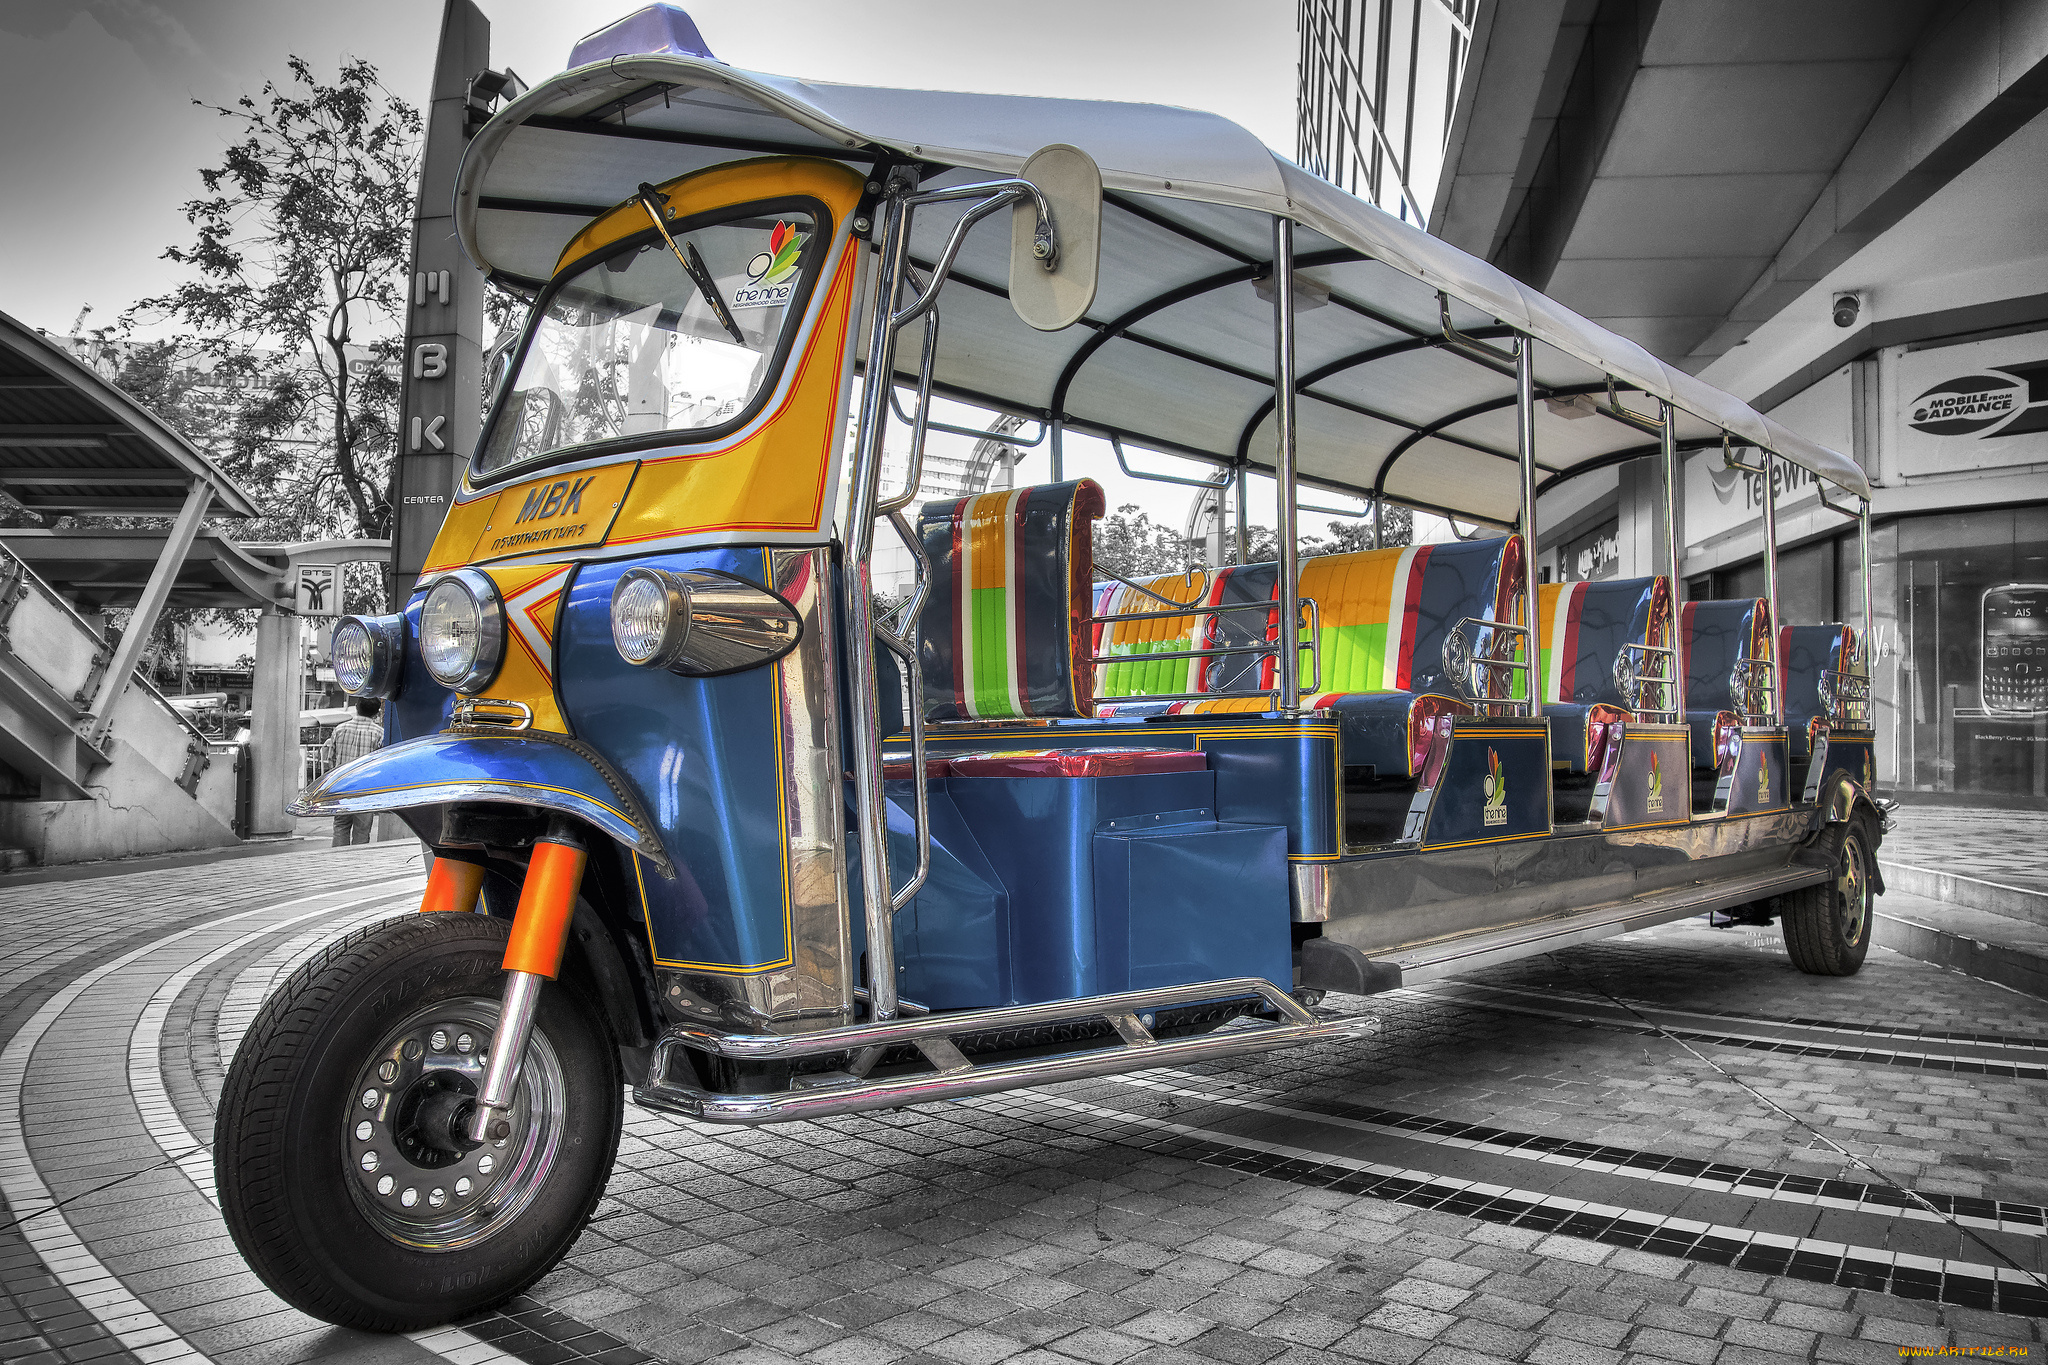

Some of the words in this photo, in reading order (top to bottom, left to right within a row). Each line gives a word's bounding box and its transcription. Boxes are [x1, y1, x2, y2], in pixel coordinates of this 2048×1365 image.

[735, 289, 758, 302] the
[759, 286, 789, 300] nine
[1928, 399, 2012, 419] ADVANCE
[1929, 393, 1989, 409] MOBILE
[1988, 393, 2013, 401] FROM
[403, 495, 444, 504] CENTER
[515, 475, 596, 524] MBK
[490, 523, 587, 553] กรุงเทพมหานคร
[2015, 607, 2032, 617] AIS
